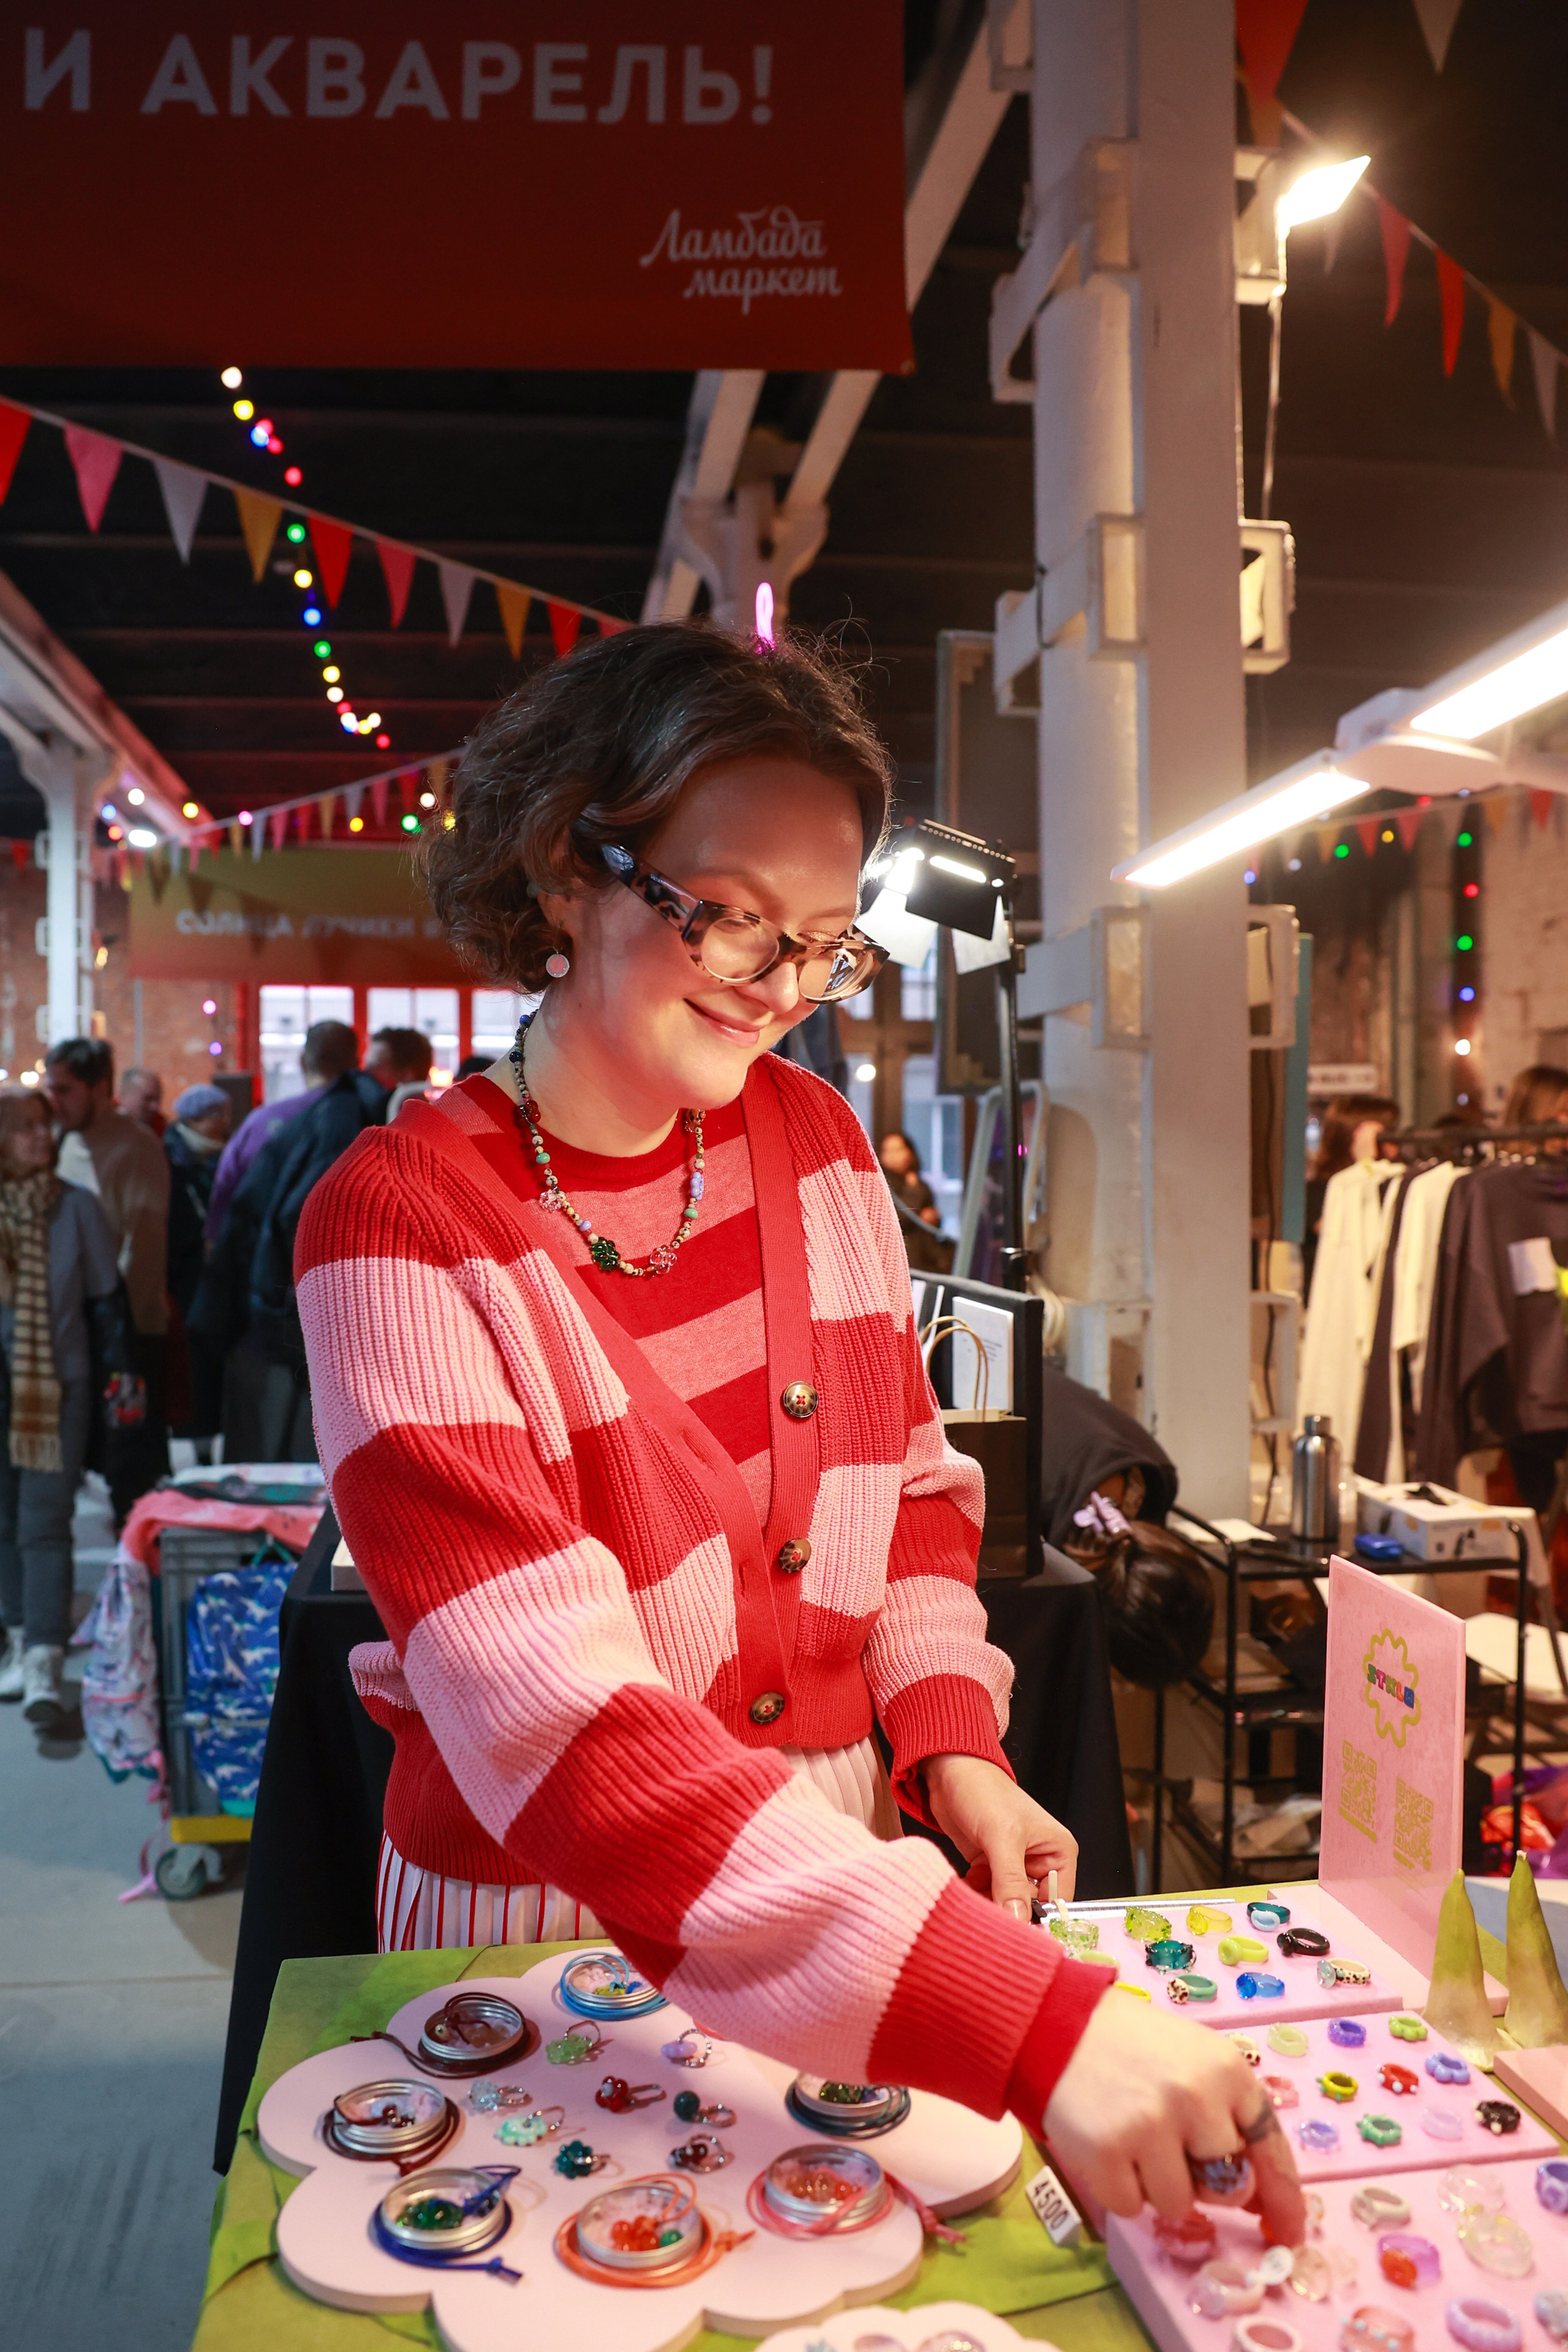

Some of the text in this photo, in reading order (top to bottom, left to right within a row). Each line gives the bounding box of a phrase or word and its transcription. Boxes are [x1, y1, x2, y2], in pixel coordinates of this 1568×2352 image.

[24, 28, 773, 124] И АКВАРЕЛЬ!
[639, 205, 827, 267] Ламбада
[682, 268, 843, 315] маркет
[1035, 2180, 1069, 2230] 4500
